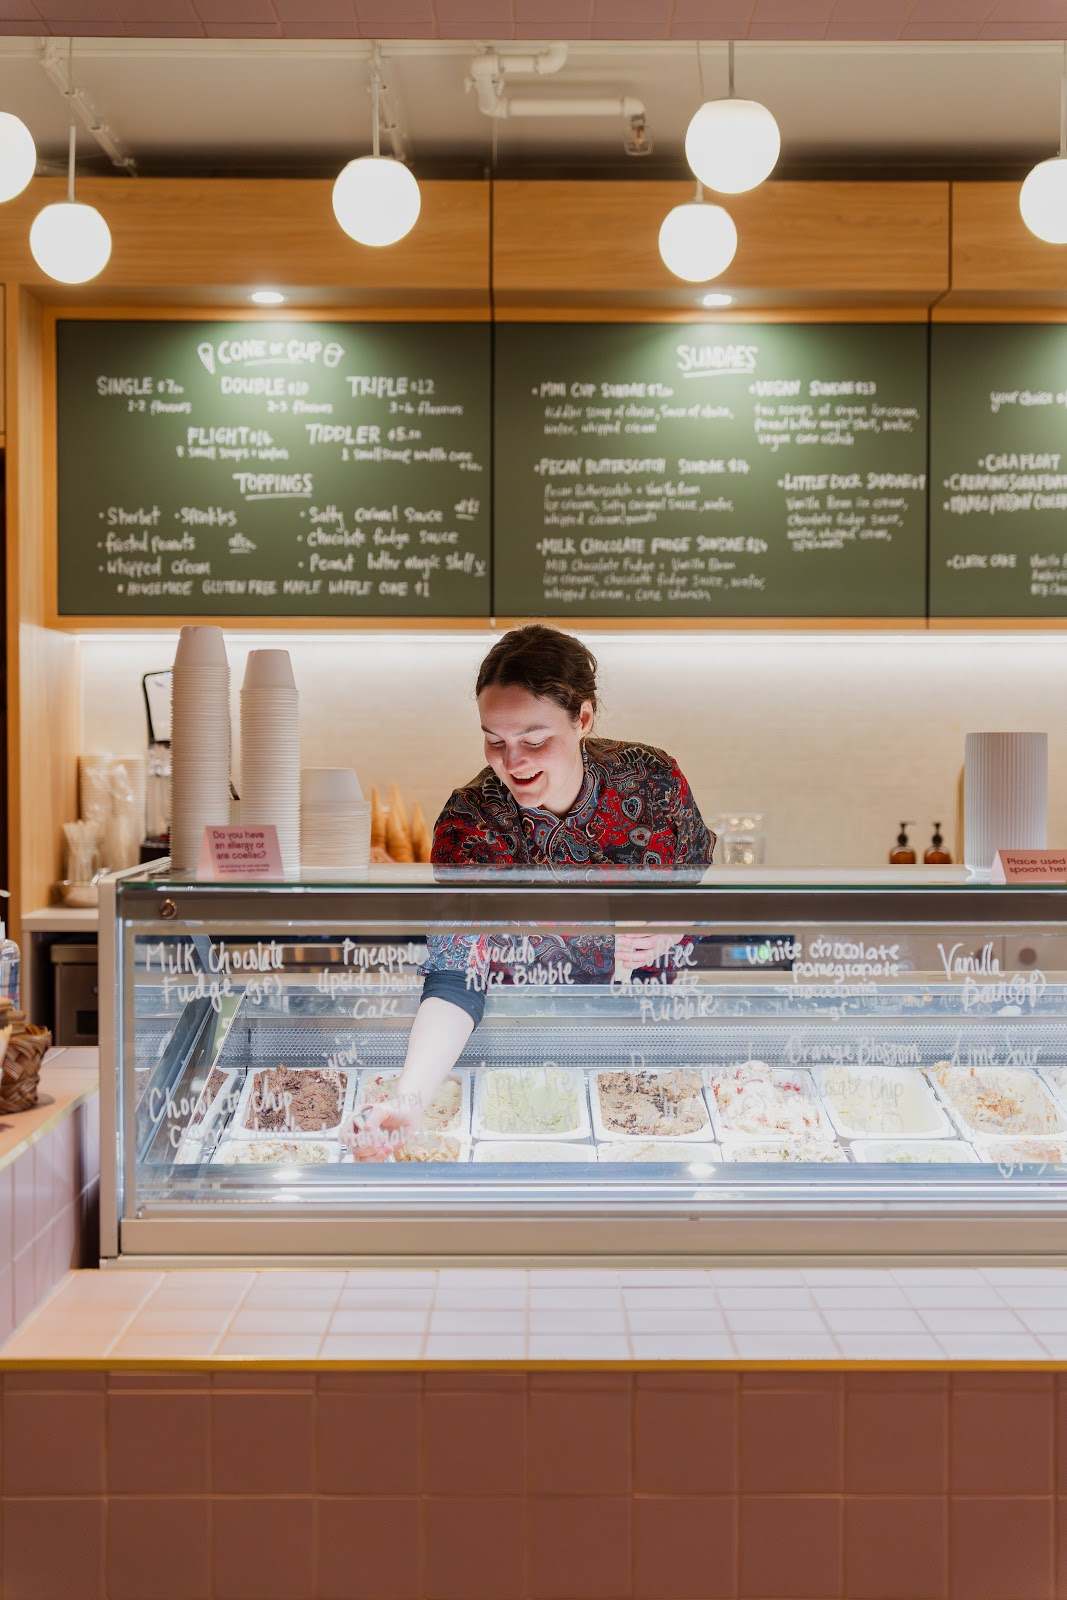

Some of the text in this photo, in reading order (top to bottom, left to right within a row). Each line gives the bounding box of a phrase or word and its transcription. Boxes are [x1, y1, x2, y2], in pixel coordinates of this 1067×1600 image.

[287, 339, 322, 363] CUP
[676, 344, 758, 371] SUNDAES
[96, 375, 153, 396] SINGLE
[221, 376, 286, 396] DOUBLE
[345, 376, 409, 398] TRIPLE
[187, 427, 249, 446] FLIGHT
[232, 473, 314, 495] TOPPINGS
[213, 831, 264, 842] Do you have
[228, 841, 254, 851] allergy
[232, 851, 266, 860] coeliac?
[1007, 857, 1066, 865] Place used
[1009, 866, 1047, 875] spoons
[207, 940, 285, 973] Chocolate
[466, 938, 535, 973] Avocado
[937, 942, 1004, 980] Vanilla
[513, 961, 575, 992] Bubble
[161, 975, 235, 1012] Fudge
